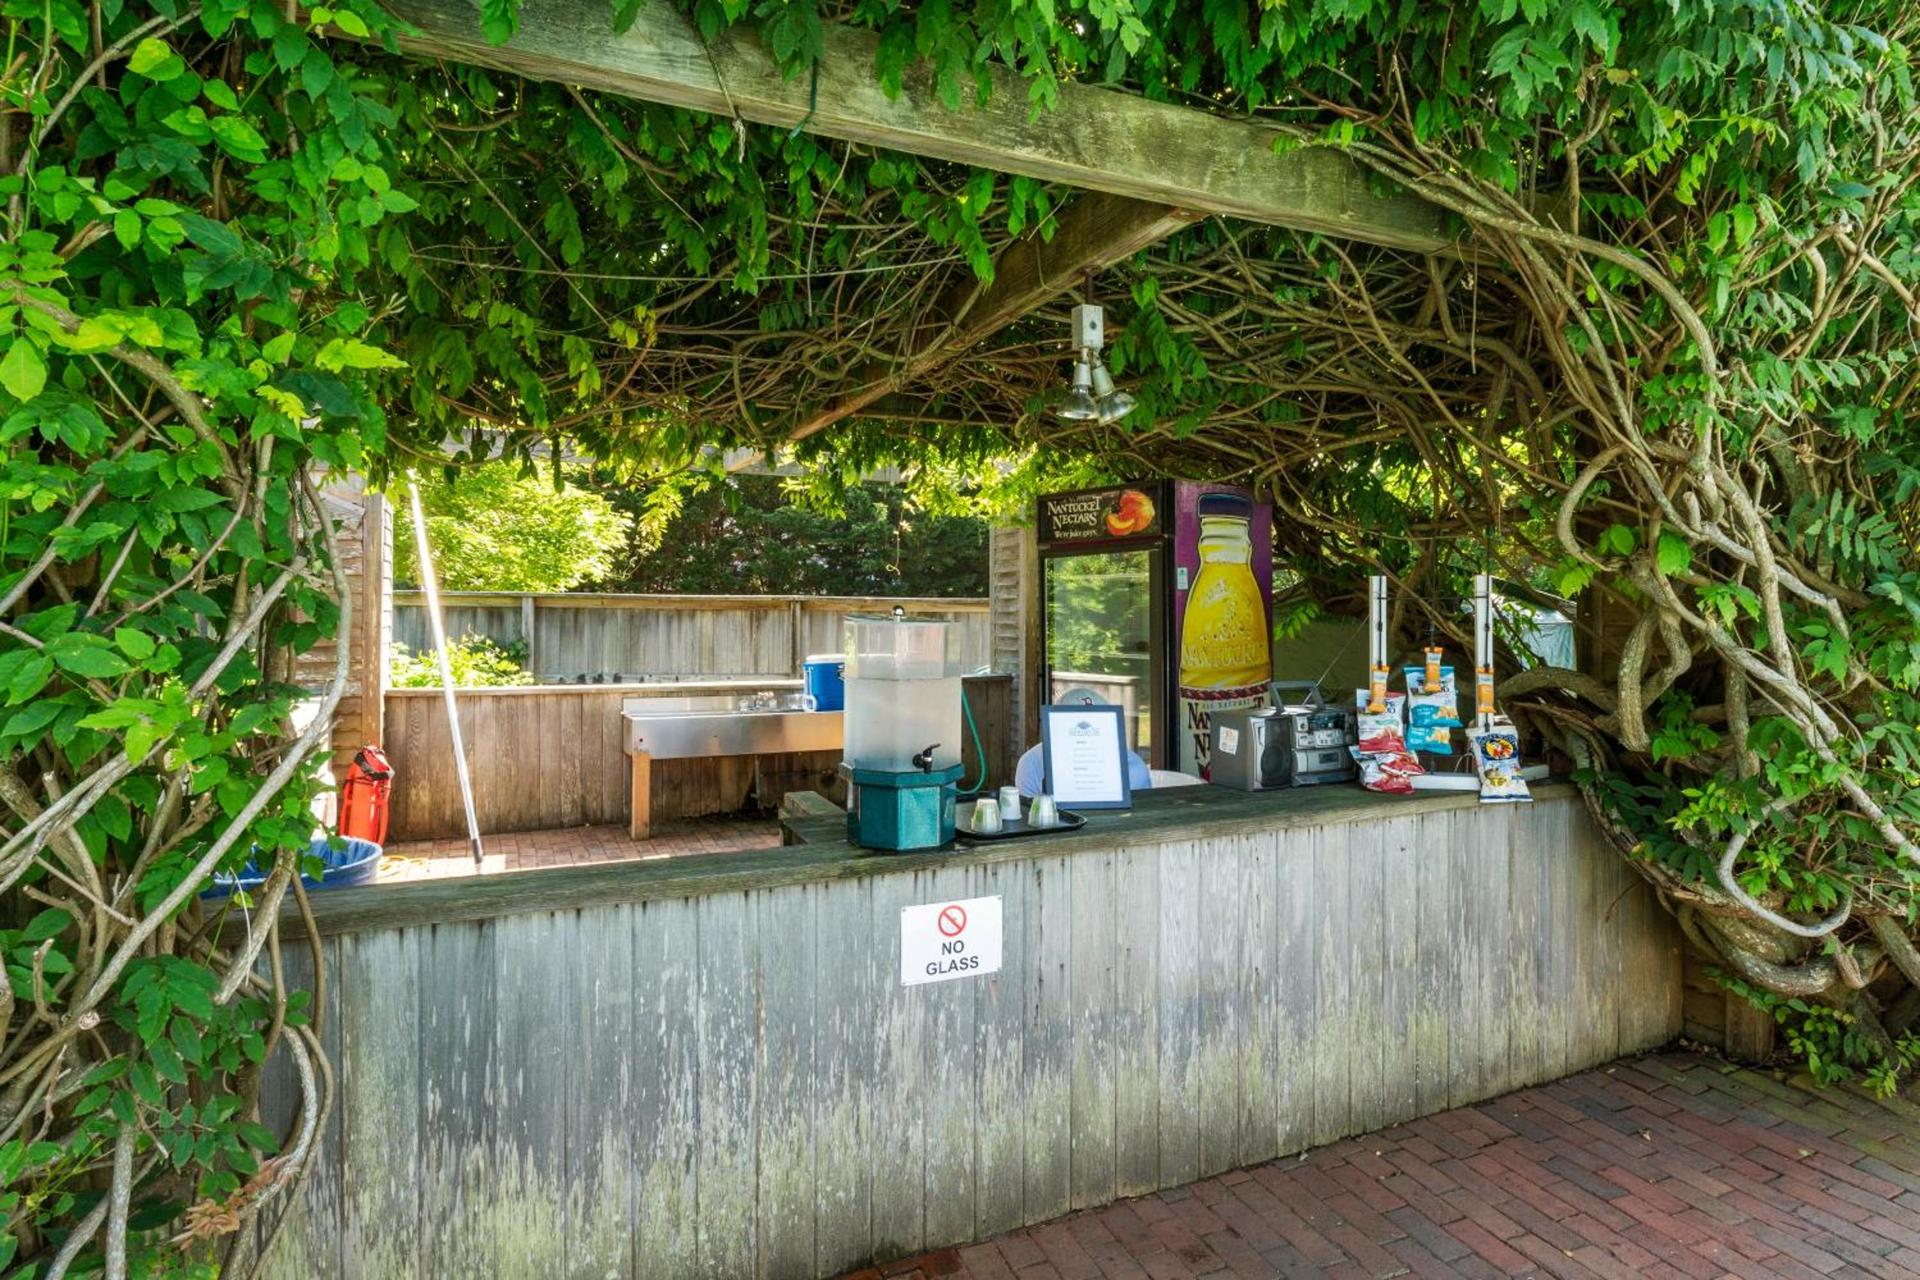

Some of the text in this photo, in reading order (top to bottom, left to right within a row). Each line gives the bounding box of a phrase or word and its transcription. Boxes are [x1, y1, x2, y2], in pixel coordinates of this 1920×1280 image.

[1047, 496, 1102, 515] NANTUCKET
[1052, 512, 1098, 530] NECTARS
[942, 940, 965, 956] NO
[926, 955, 979, 976] GLASS
